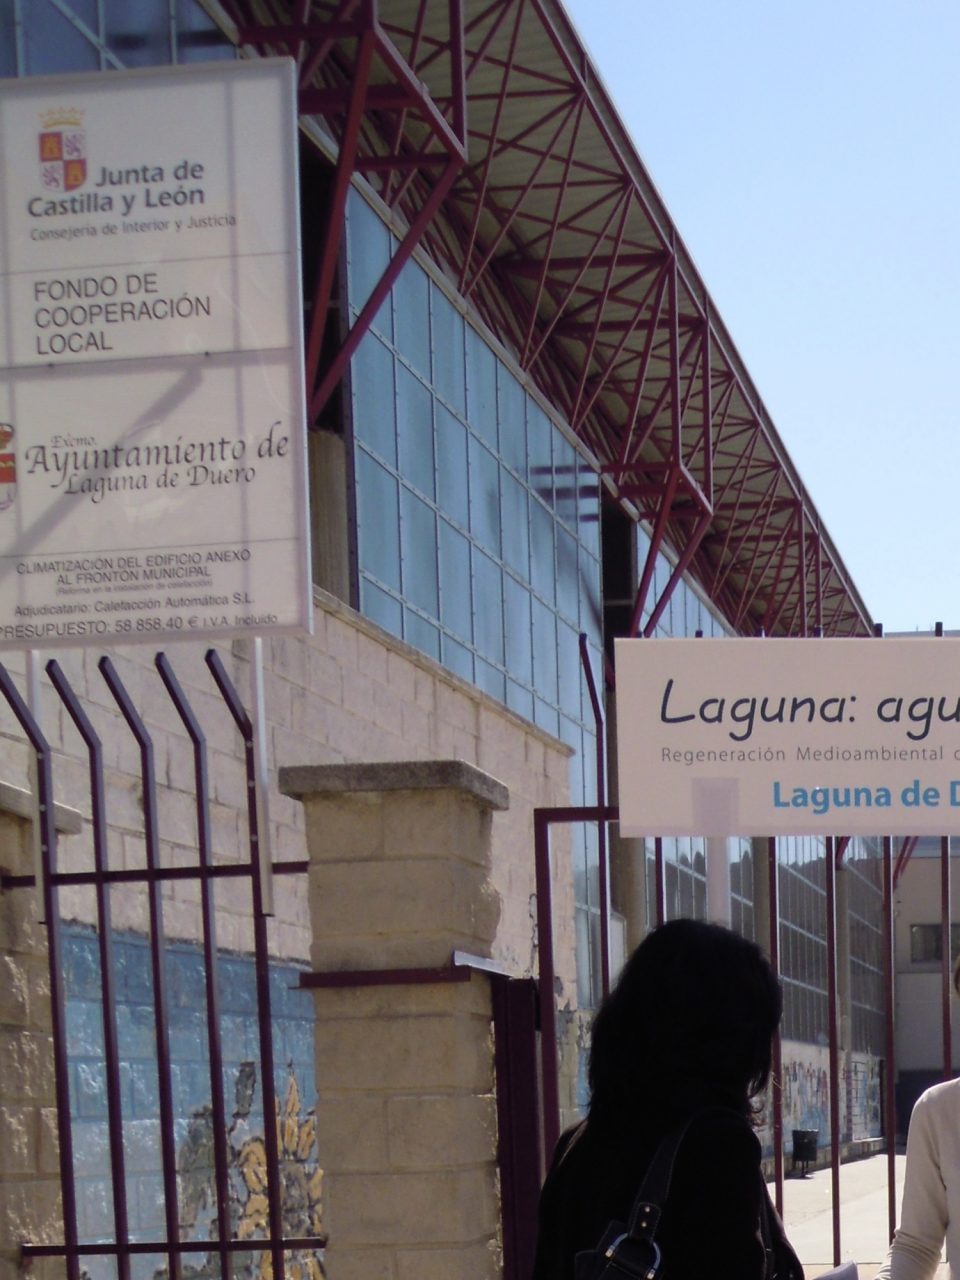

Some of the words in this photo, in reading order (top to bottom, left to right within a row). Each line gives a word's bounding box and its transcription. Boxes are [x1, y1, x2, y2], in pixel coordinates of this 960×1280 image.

[96, 166, 164, 187] Junta
[173, 161, 205, 180] de
[27, 193, 113, 217] Castilla
[121, 195, 136, 216] y
[144, 185, 205, 208] León
[102, 222, 118, 236] de
[122, 217, 170, 233] Interior
[175, 219, 182, 231] y
[187, 213, 237, 229] Justicia
[34, 275, 118, 302] FONDO
[126, 273, 159, 294] DE
[35, 292, 211, 328] COOPERACIÓN
[36, 331, 113, 355] LOCAL
[25, 436, 246, 488] Ayuntamiento
[257, 420, 289, 458] de
[64, 472, 148, 504] Laguna
[156, 466, 179, 488] de
[187, 464, 256, 487] Duero
[117, 556, 141, 568] DEL
[146, 552, 202, 567] EDIFICIO
[206, 549, 251, 563] ANEXO
[57, 574, 72, 585] AL
[143, 565, 211, 580] MUNICIPAL
[660, 679, 857, 742] Laguna:
[661, 747, 786, 766] Regeneración
[797, 746, 944, 761] Medioambiental
[773, 781, 892, 815] Laguna
[901, 779, 941, 807] de
